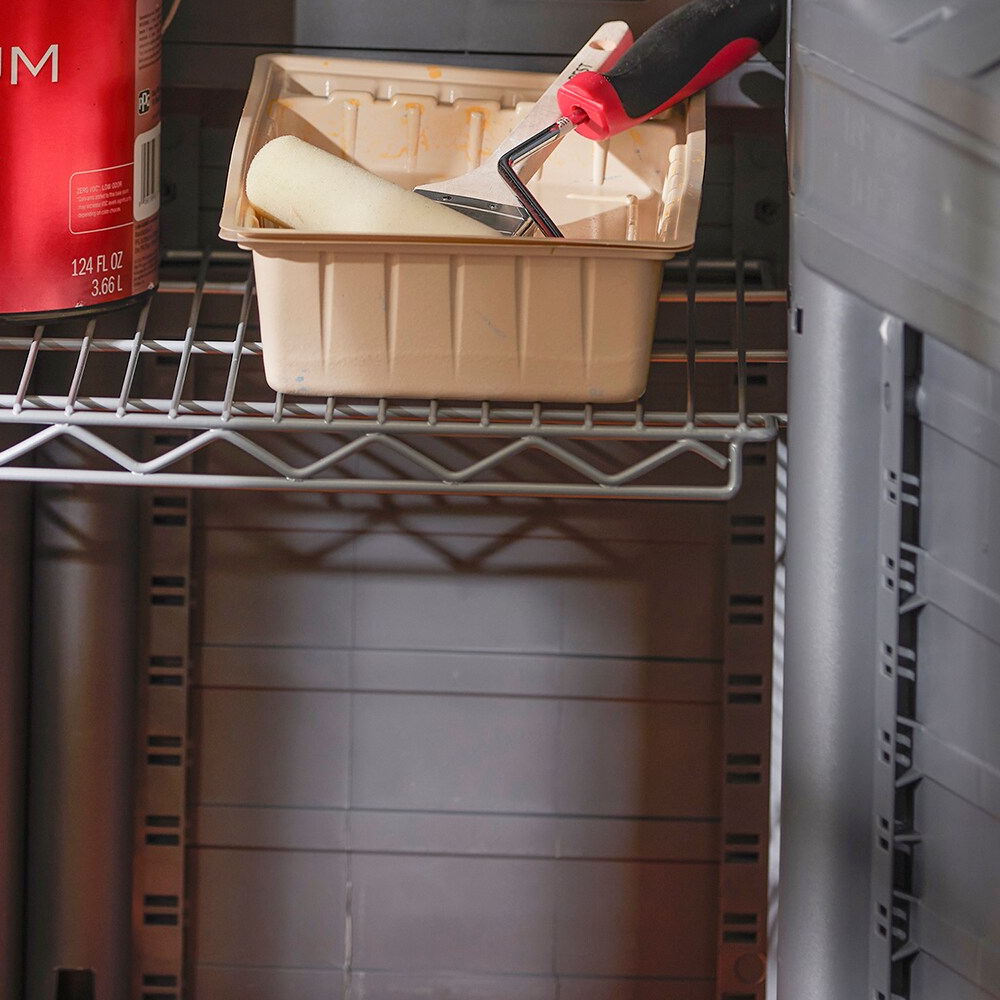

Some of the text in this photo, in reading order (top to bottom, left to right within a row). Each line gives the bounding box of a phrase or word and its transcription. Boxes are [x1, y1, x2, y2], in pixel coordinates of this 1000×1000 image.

[71, 251, 123, 276] 124 FL OZ
[91, 275, 122, 297] 3.66 L
